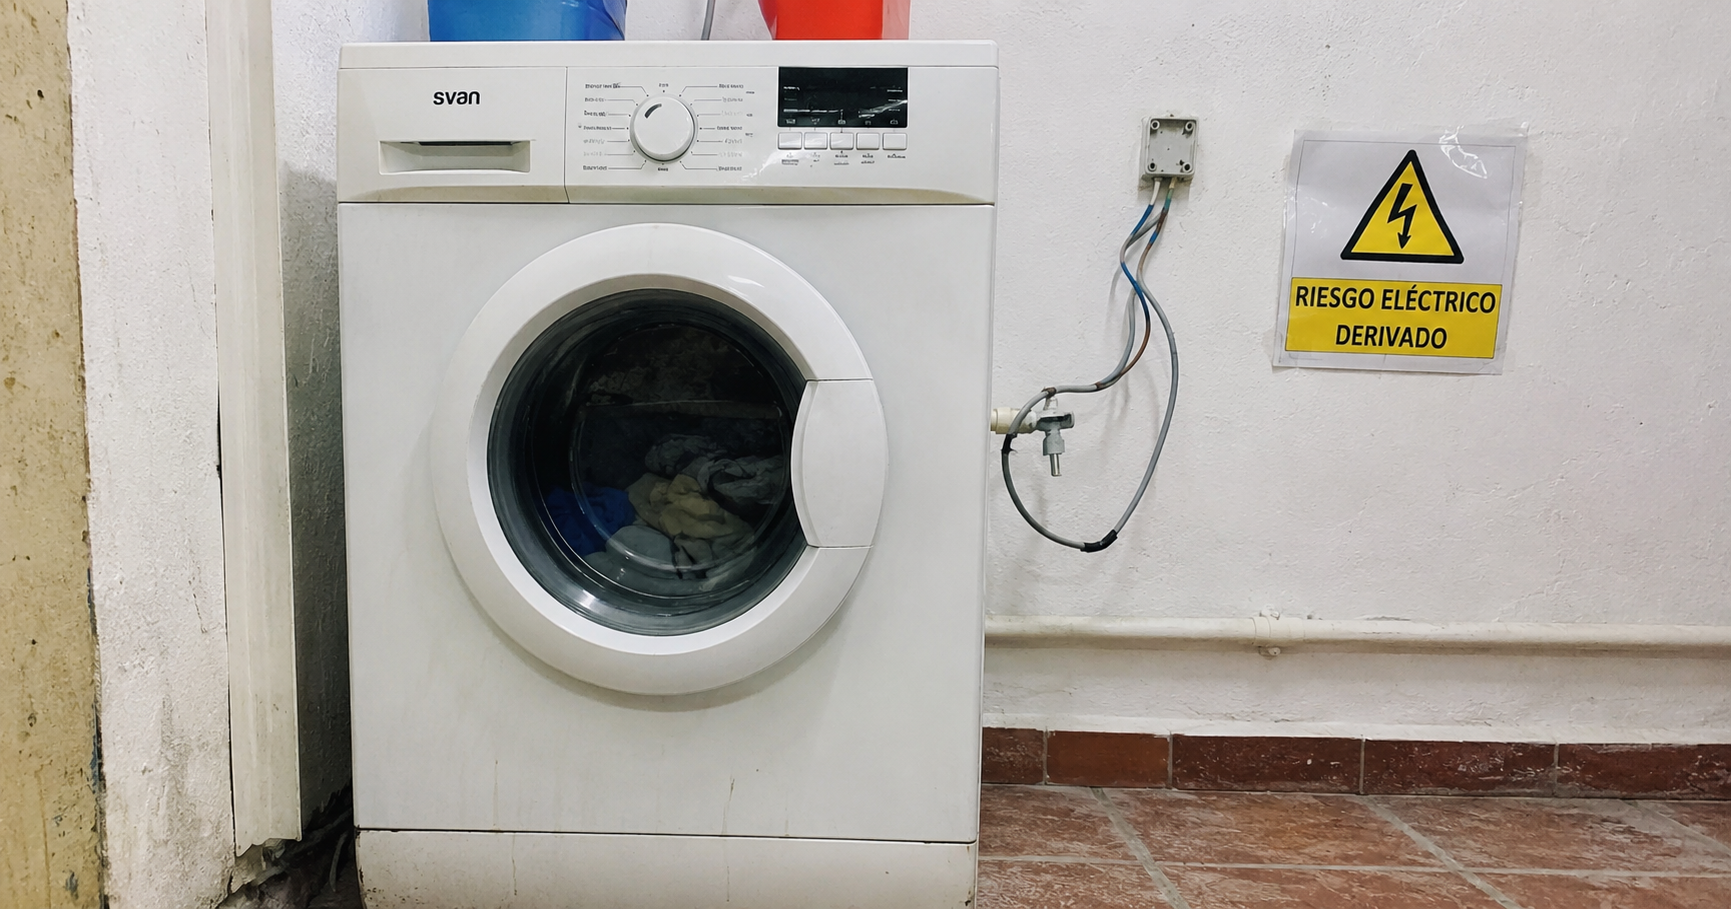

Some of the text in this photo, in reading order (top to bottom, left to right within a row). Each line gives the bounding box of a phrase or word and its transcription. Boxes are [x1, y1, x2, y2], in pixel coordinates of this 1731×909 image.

[433, 91, 481, 105] svan
[1295, 284, 1496, 313] RIESGO ELÉCTRICO
[1335, 324, 1448, 349] DERIVADO
